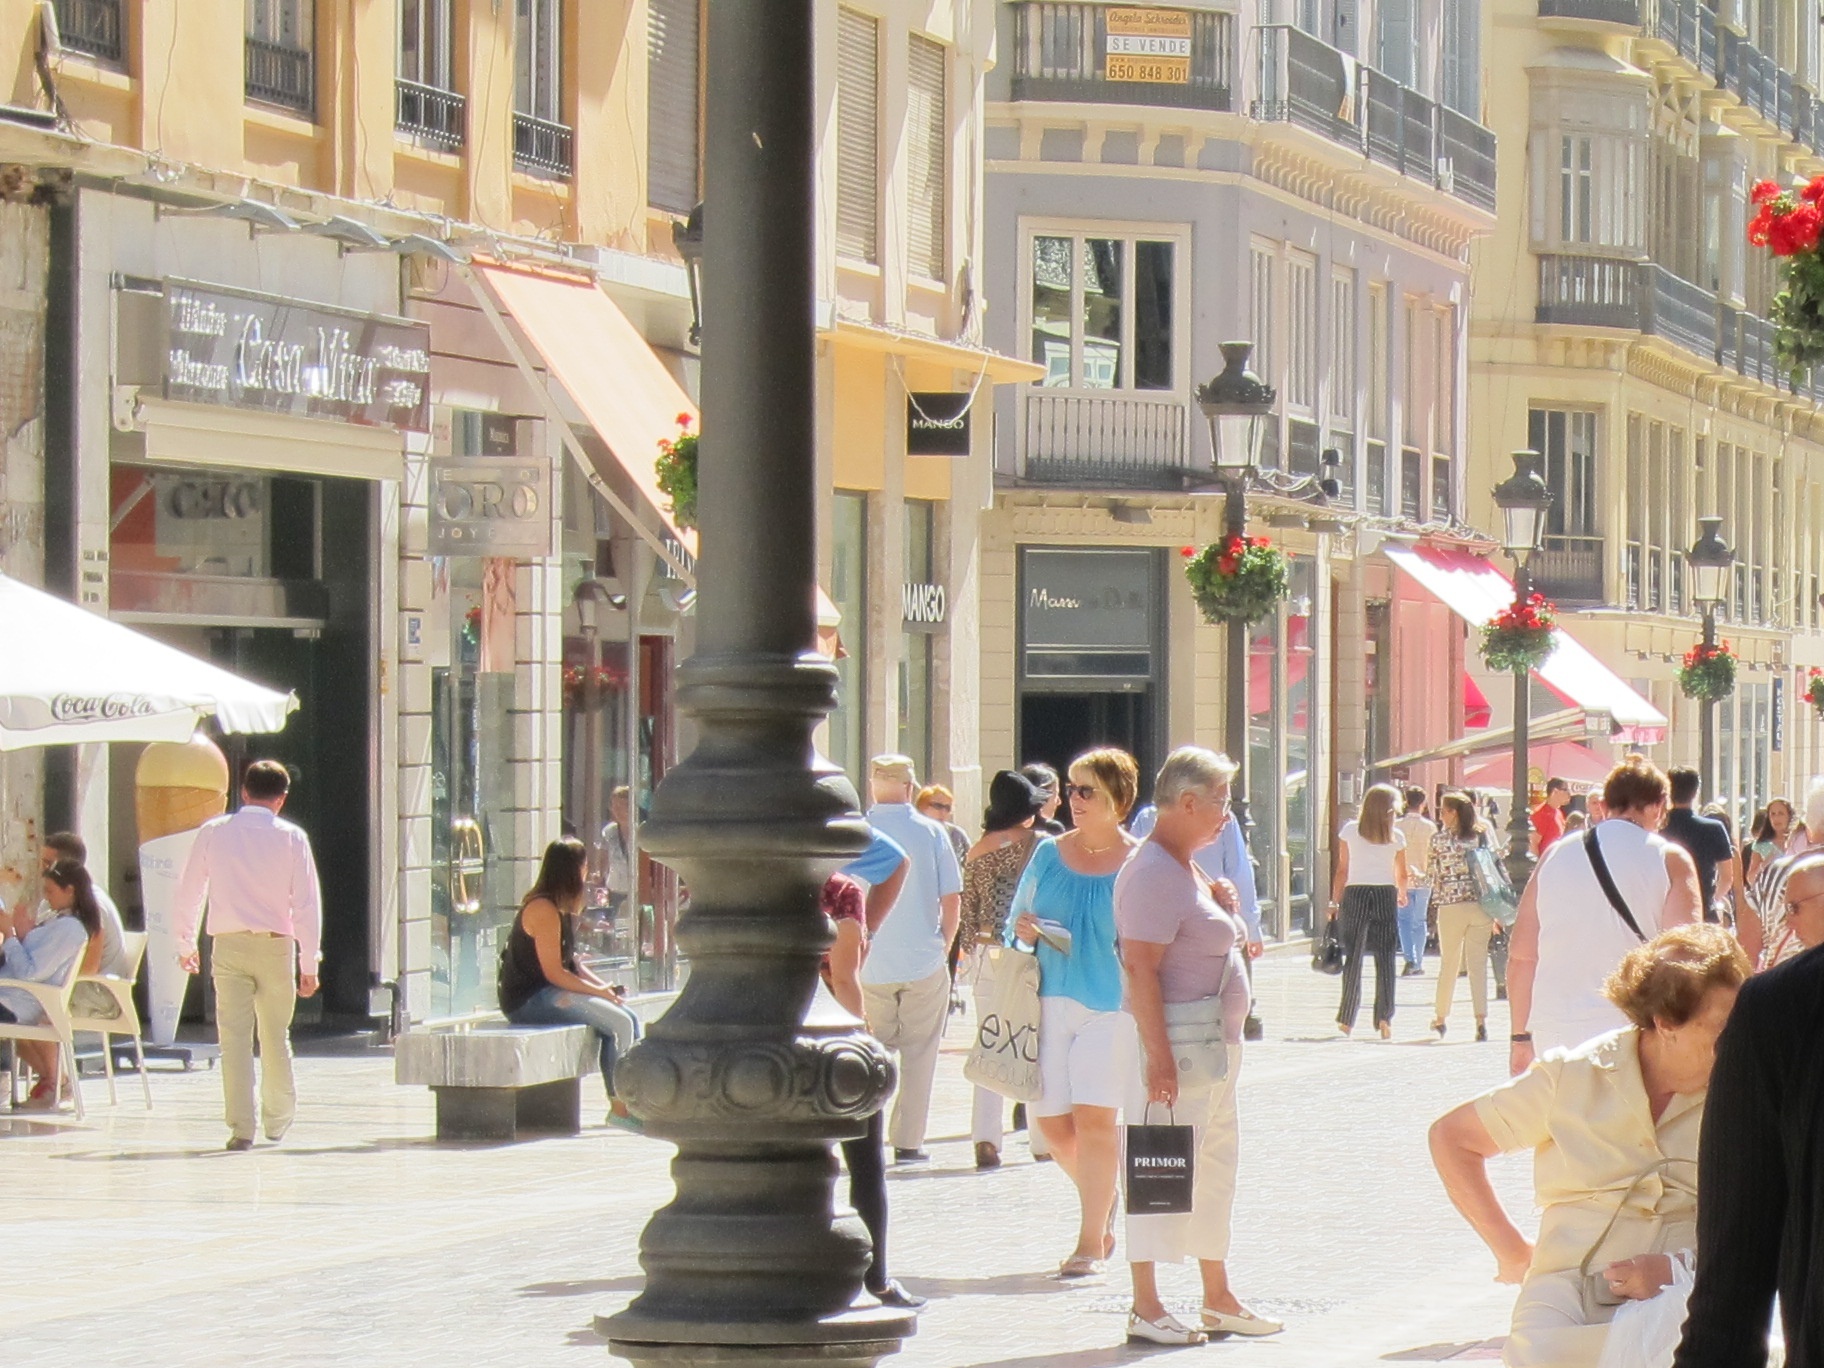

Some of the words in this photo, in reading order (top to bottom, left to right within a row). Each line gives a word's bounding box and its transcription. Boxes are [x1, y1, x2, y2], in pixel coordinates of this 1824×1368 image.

[1112, 37, 1130, 51] SE
[1139, 39, 1186, 53] VENDE
[1109, 64, 1134, 79] 650
[1140, 65, 1162, 80] 848
[1168, 66, 1187, 81] 301
[912, 418, 965, 430] MANGO
[901, 583, 945, 622] MANGO
[1134, 1157, 1187, 1168] PRIMOR
